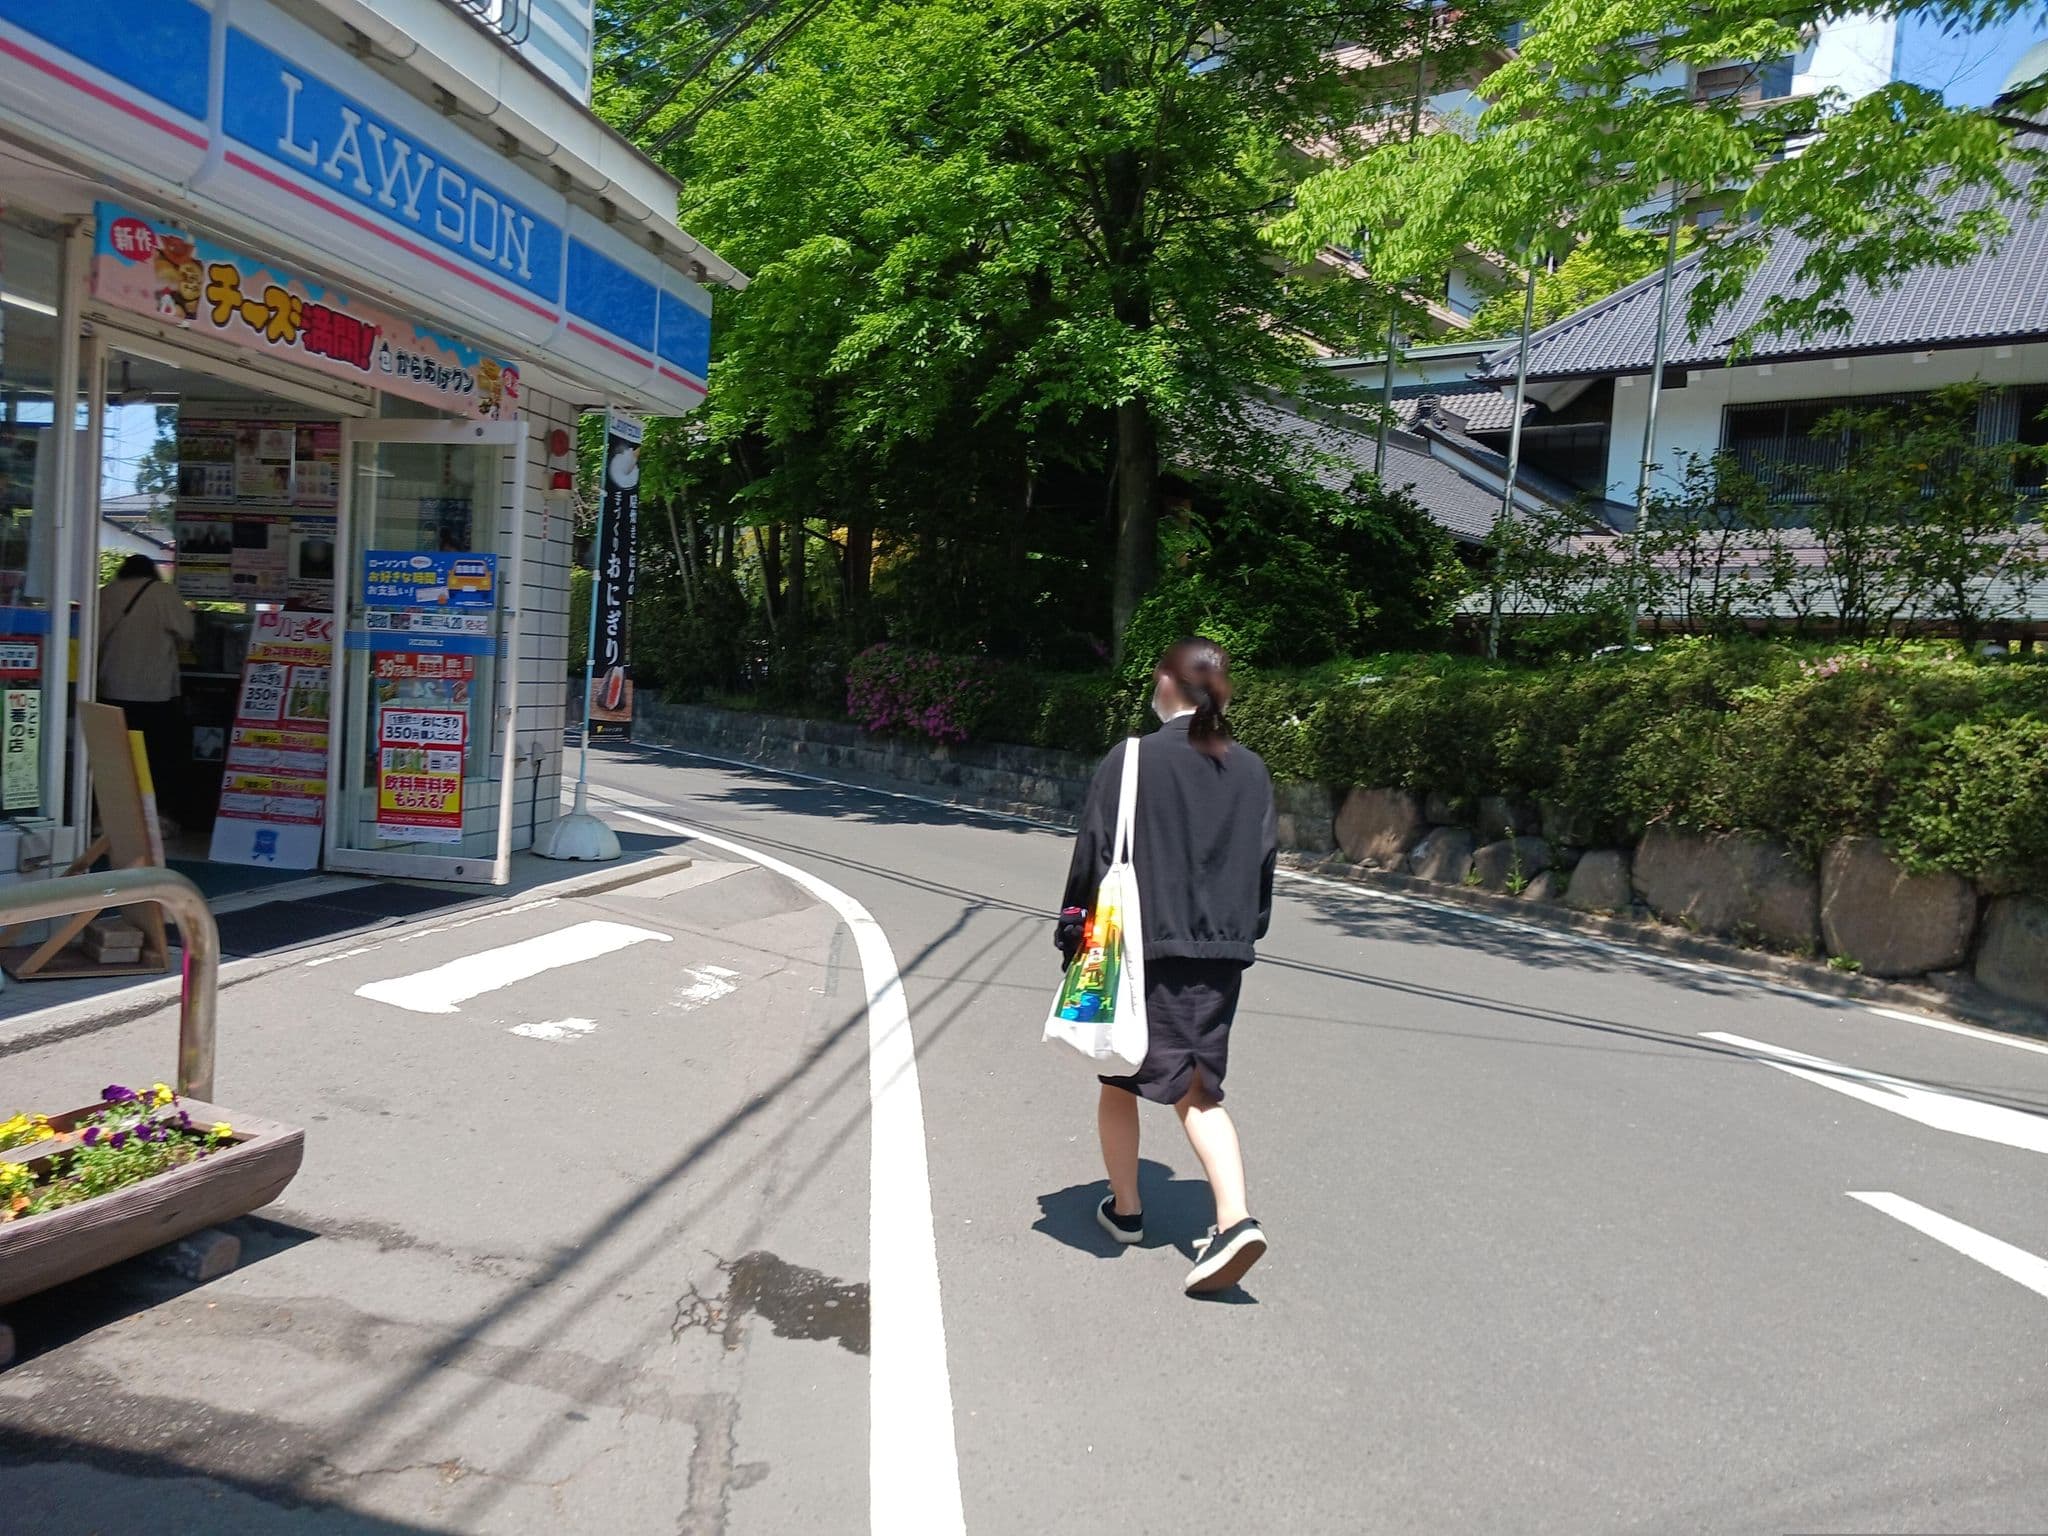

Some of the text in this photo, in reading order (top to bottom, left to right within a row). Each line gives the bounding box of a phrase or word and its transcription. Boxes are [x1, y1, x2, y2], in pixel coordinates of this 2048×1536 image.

[278, 71, 534, 280] LAWSON
[113, 226, 156, 253] 新作
[396, 349, 475, 394] からあげクン
[421, 715, 460, 728] おにぎり
[384, 775, 457, 794] 飲料無料券
[394, 792, 446, 809] もらえる!
